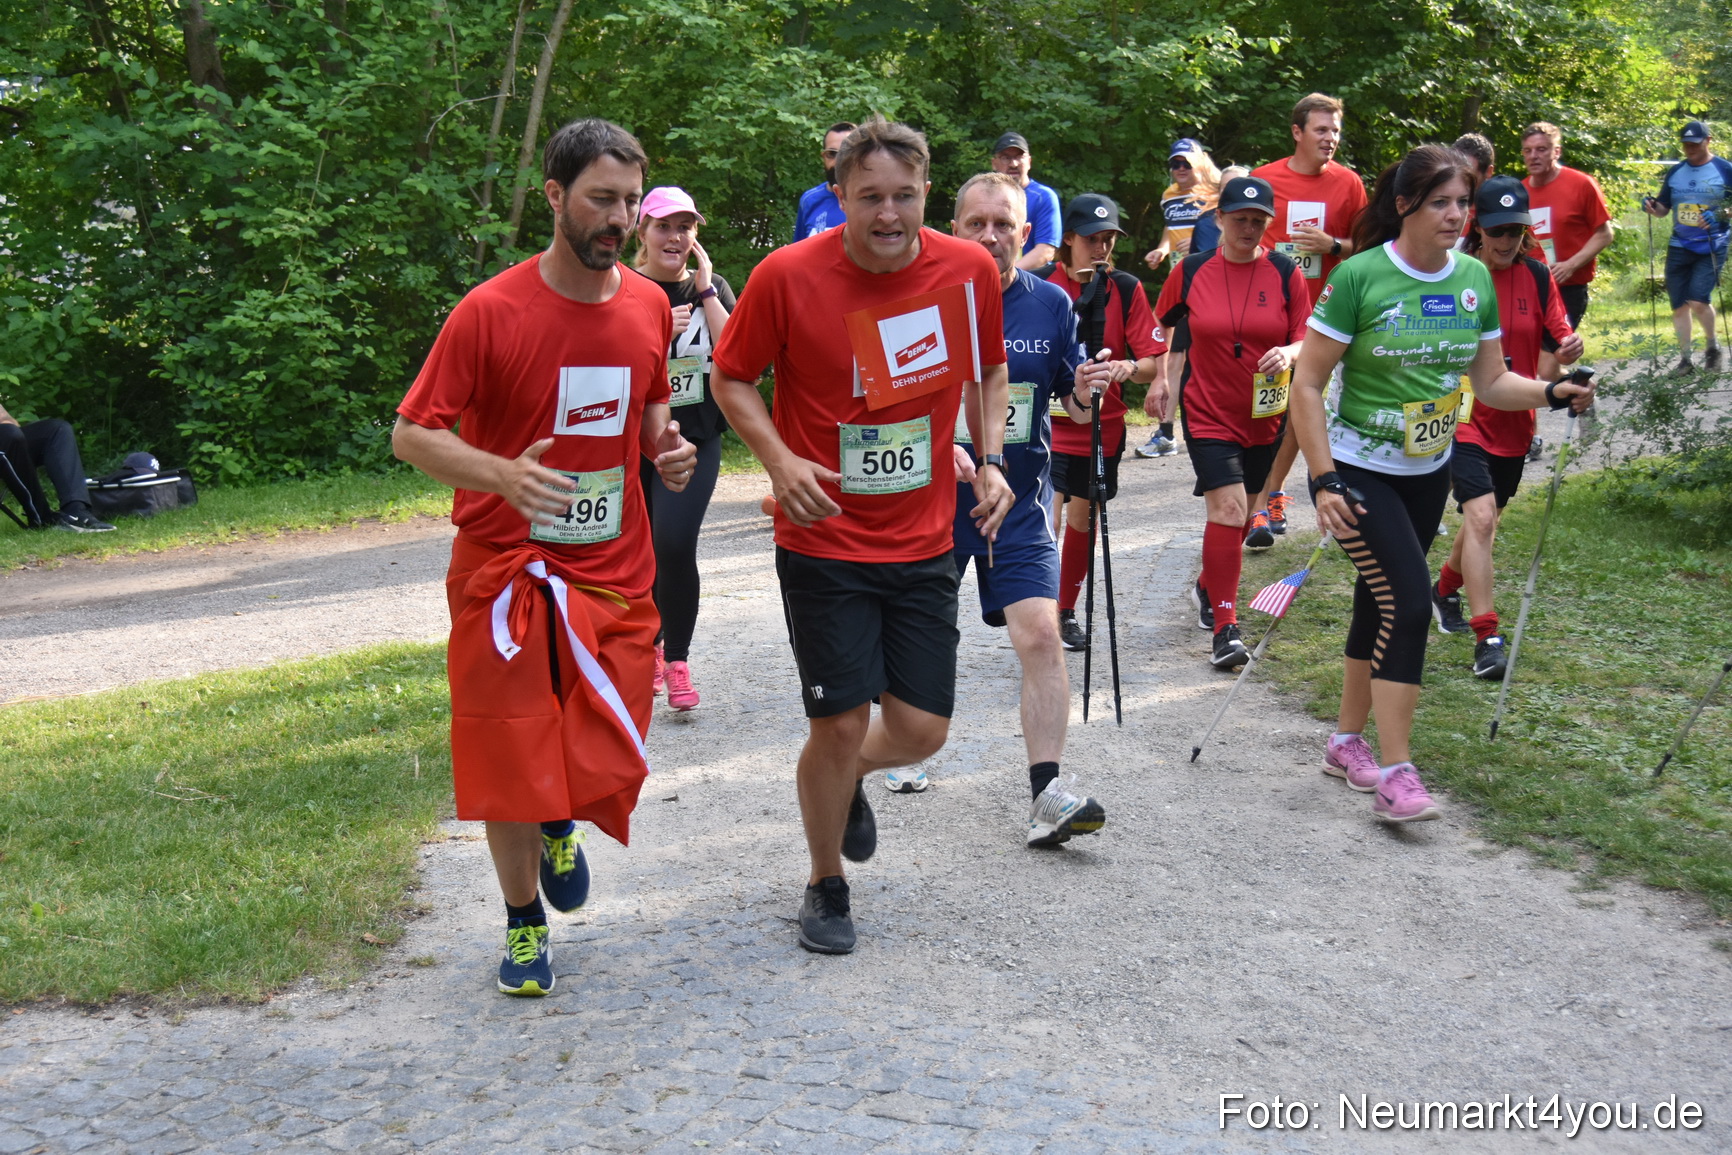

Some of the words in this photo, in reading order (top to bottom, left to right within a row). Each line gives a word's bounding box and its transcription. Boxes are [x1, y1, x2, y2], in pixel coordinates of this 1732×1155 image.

[1168, 209, 1201, 218] Fischer
[1428, 302, 1454, 310] Fischer
[1406, 314, 1481, 329] firmenlau
[907, 342, 927, 359] DEHN
[1004, 340, 1050, 354] POLES
[1372, 342, 1433, 357] Gesunde
[1401, 355, 1440, 367] laufen
[1446, 353, 1475, 367] länge
[892, 375, 917, 389] DEHN
[918, 365, 950, 384] protects.
[1259, 385, 1287, 405] 2366
[580, 407, 606, 419] DEHN
[1414, 408, 1456, 443] 2084
[862, 447, 914, 475] 506
[846, 473, 906, 483] Kerschensteiner
[908, 469, 927, 479] Tobias
[555, 496, 608, 525] 496
[553, 524, 580, 532] Hilbich
[581, 523, 608, 532] Andreas
